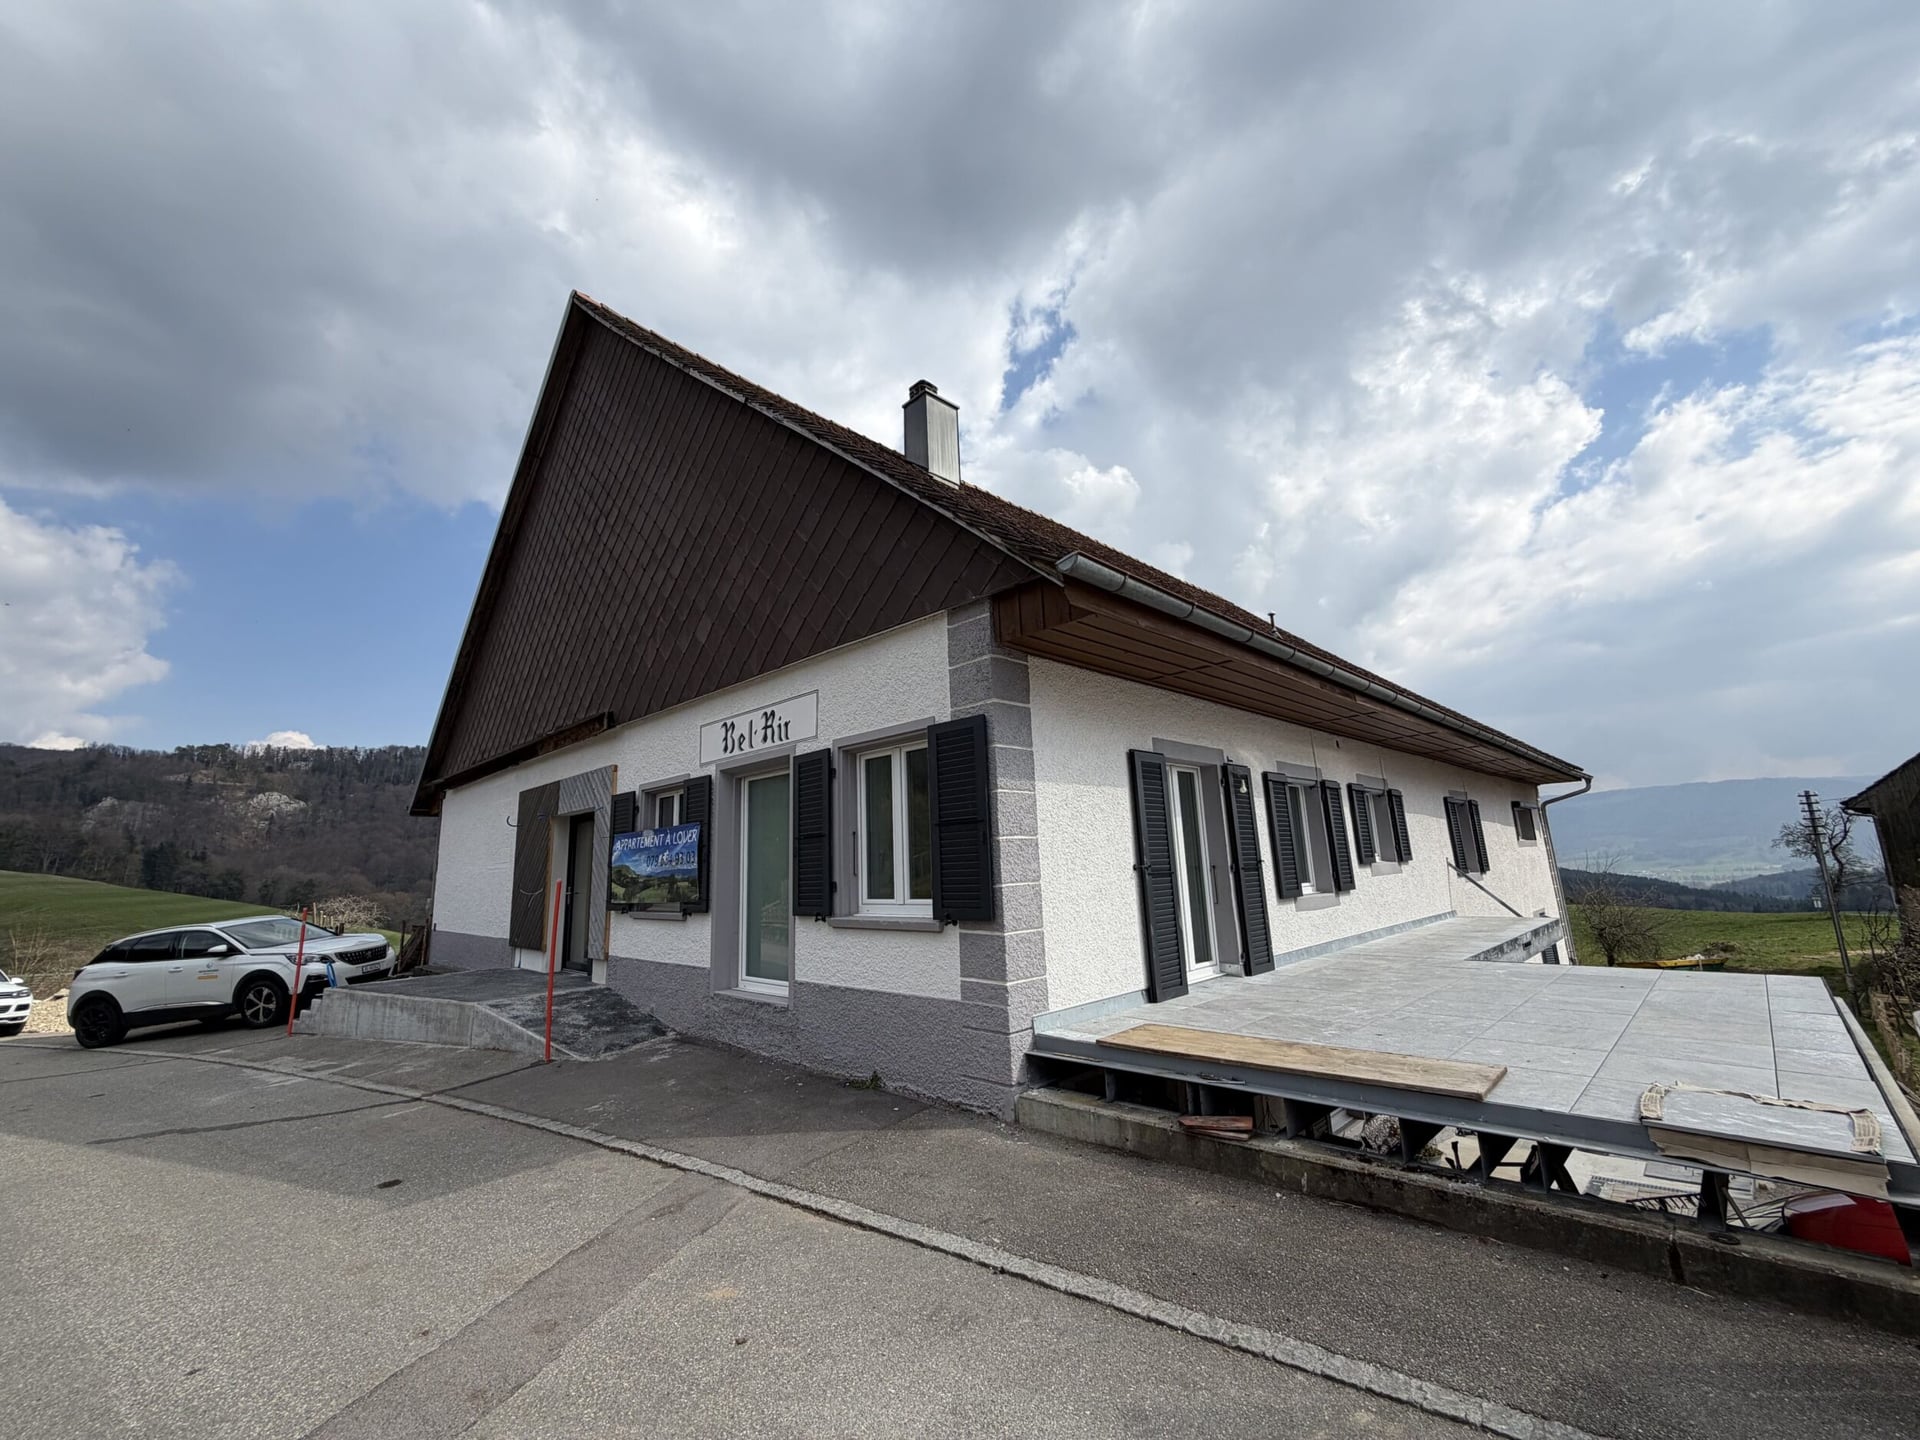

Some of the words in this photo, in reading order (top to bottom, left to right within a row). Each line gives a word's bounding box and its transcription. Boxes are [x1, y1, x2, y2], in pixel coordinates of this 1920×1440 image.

[616, 834, 664, 850] APPARTEMENT
[672, 829, 698, 844] LOUER
[646, 855, 659, 867] 079
[686, 851, 696, 864] 03
